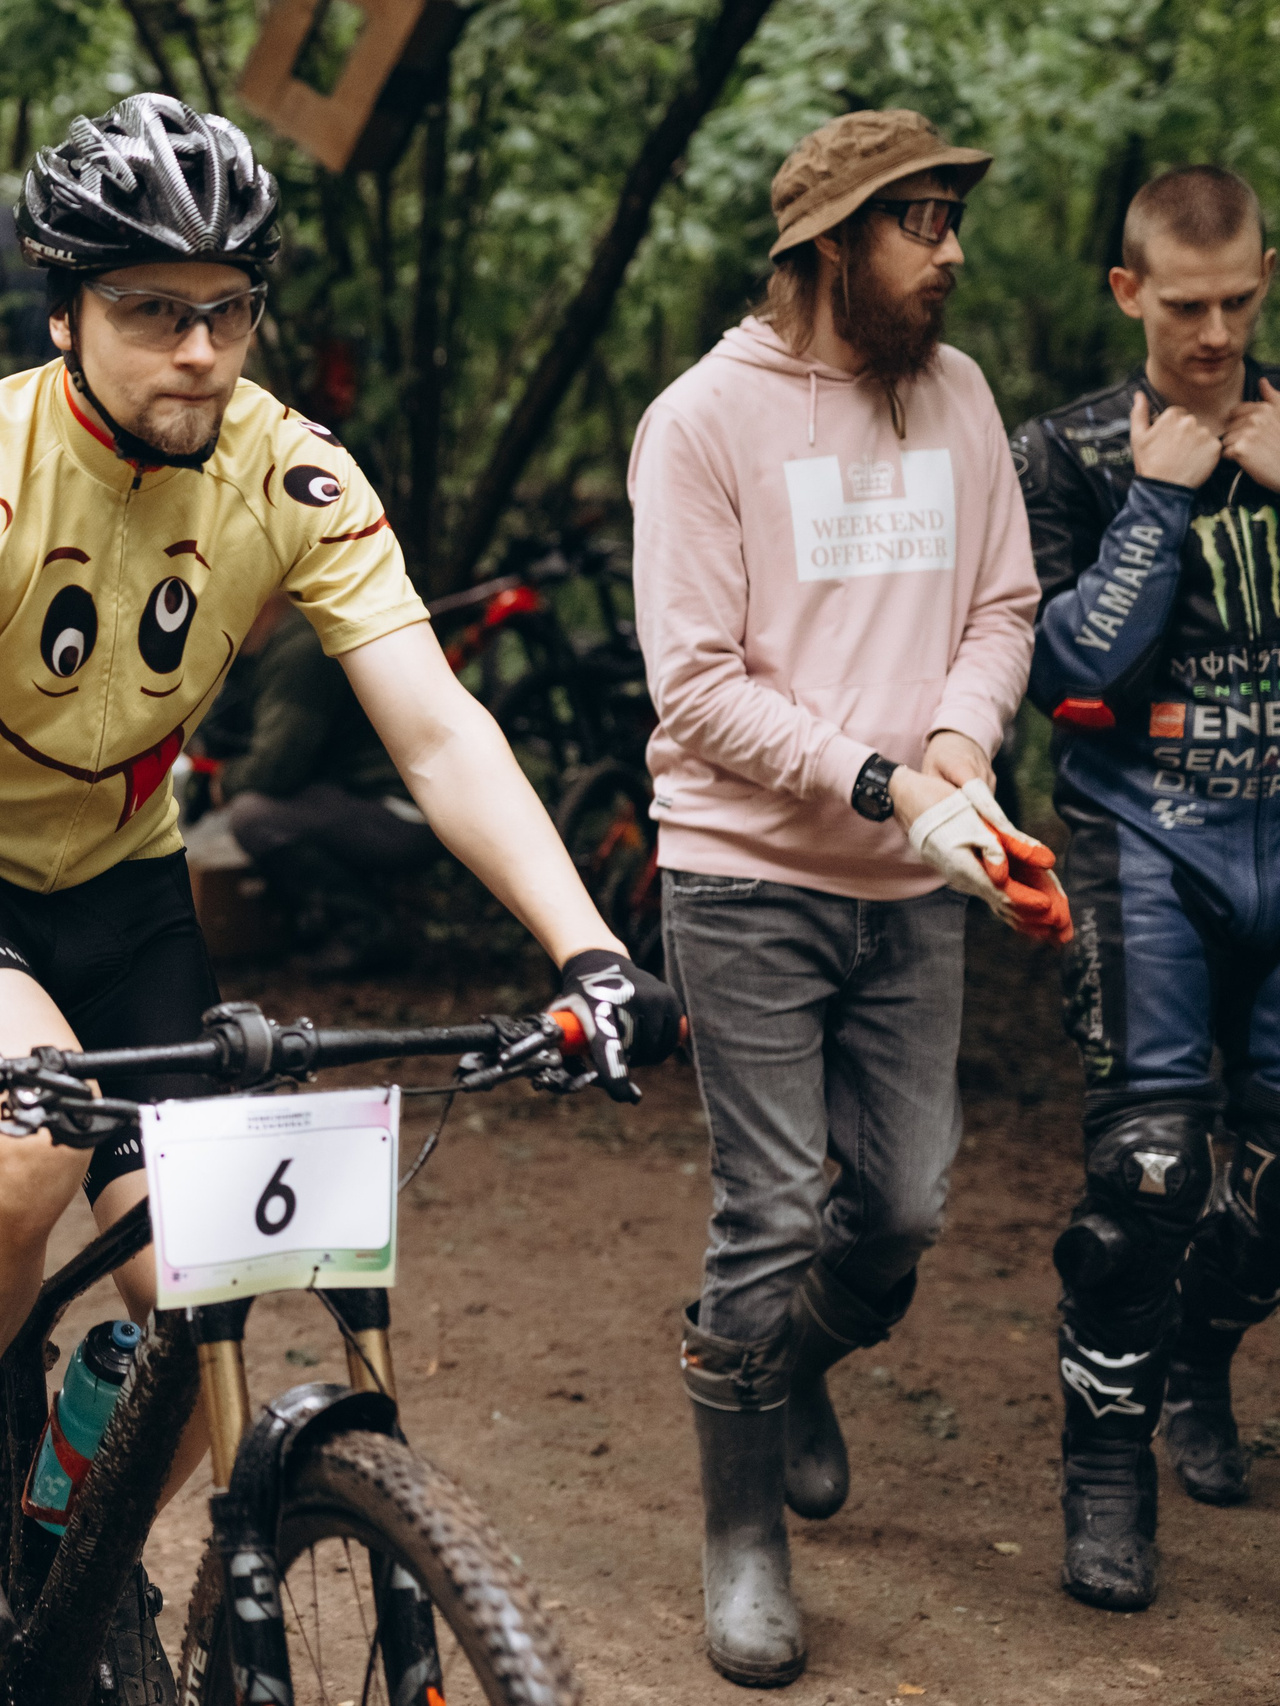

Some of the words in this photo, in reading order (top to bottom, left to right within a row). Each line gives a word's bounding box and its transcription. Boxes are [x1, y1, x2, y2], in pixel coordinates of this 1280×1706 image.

[810, 537, 948, 568] OFFENDER
[1075, 525, 1164, 652] YAMAHA
[1193, 679, 1280, 698] ENER
[255, 1158, 296, 1236] 6
